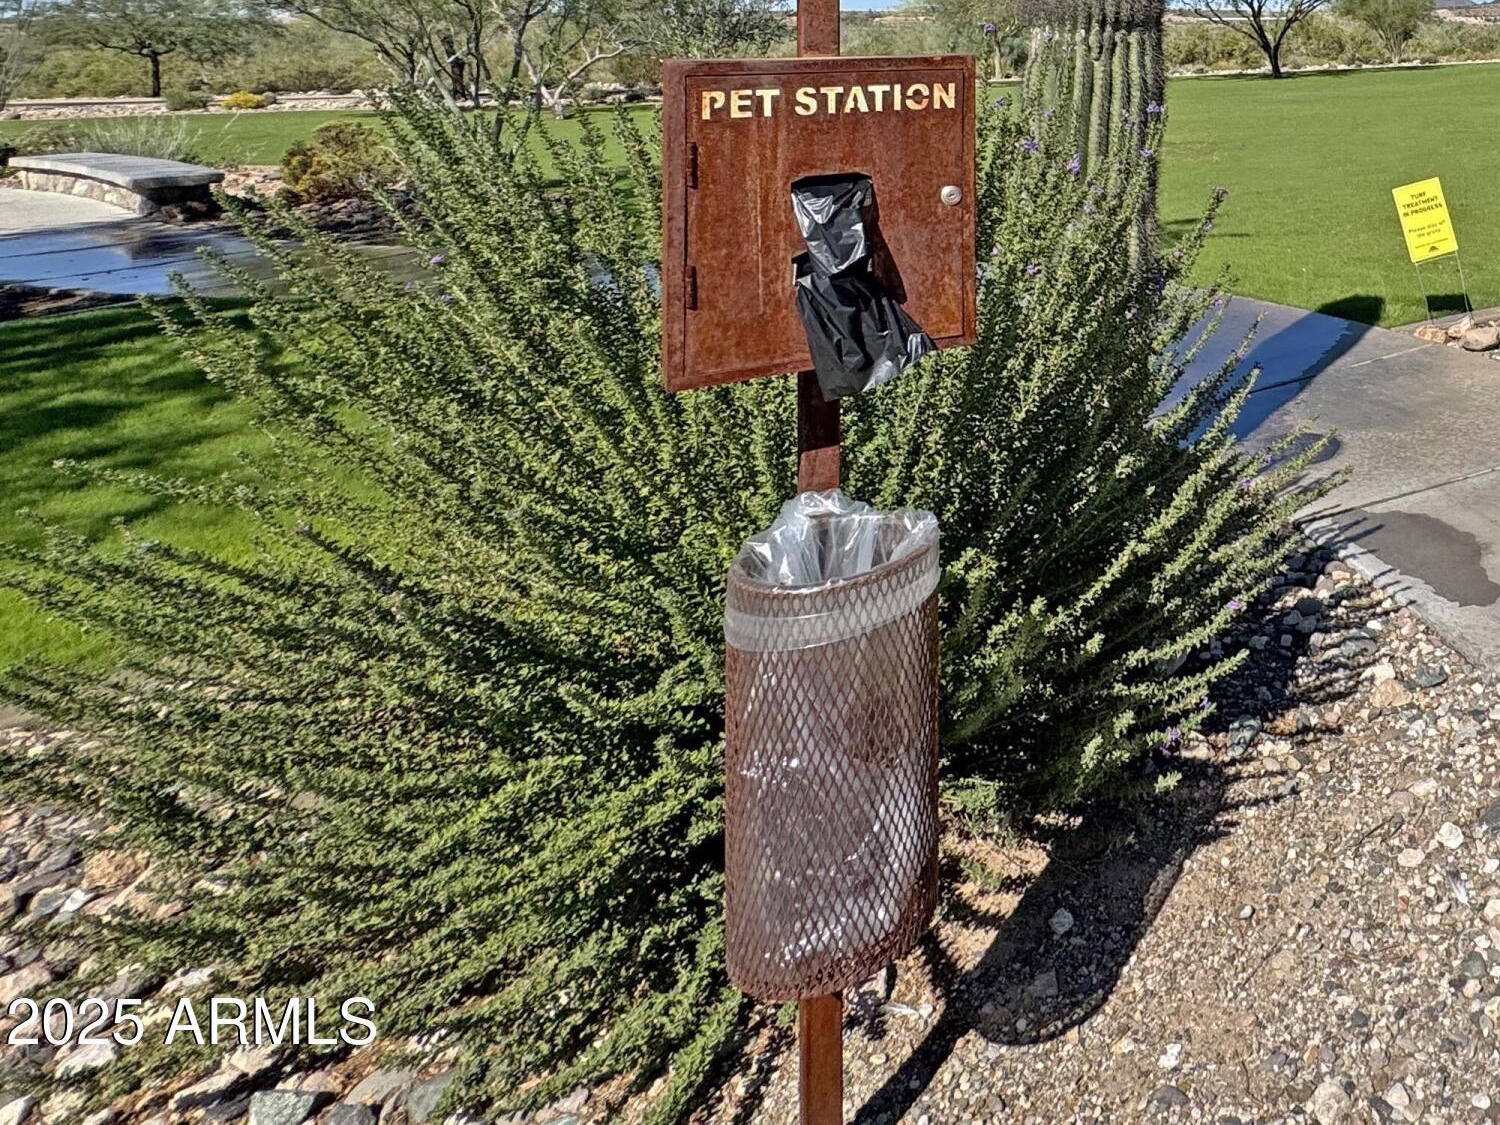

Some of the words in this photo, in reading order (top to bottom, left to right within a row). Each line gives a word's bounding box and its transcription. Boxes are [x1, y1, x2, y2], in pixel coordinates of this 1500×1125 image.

[701, 88, 780, 120] PET
[794, 82, 956, 116] STATION
[1402, 195, 1439, 210] TREATMENT
[1410, 191, 1426, 200] TURF
[1411, 202, 1443, 216] PROGRESS
